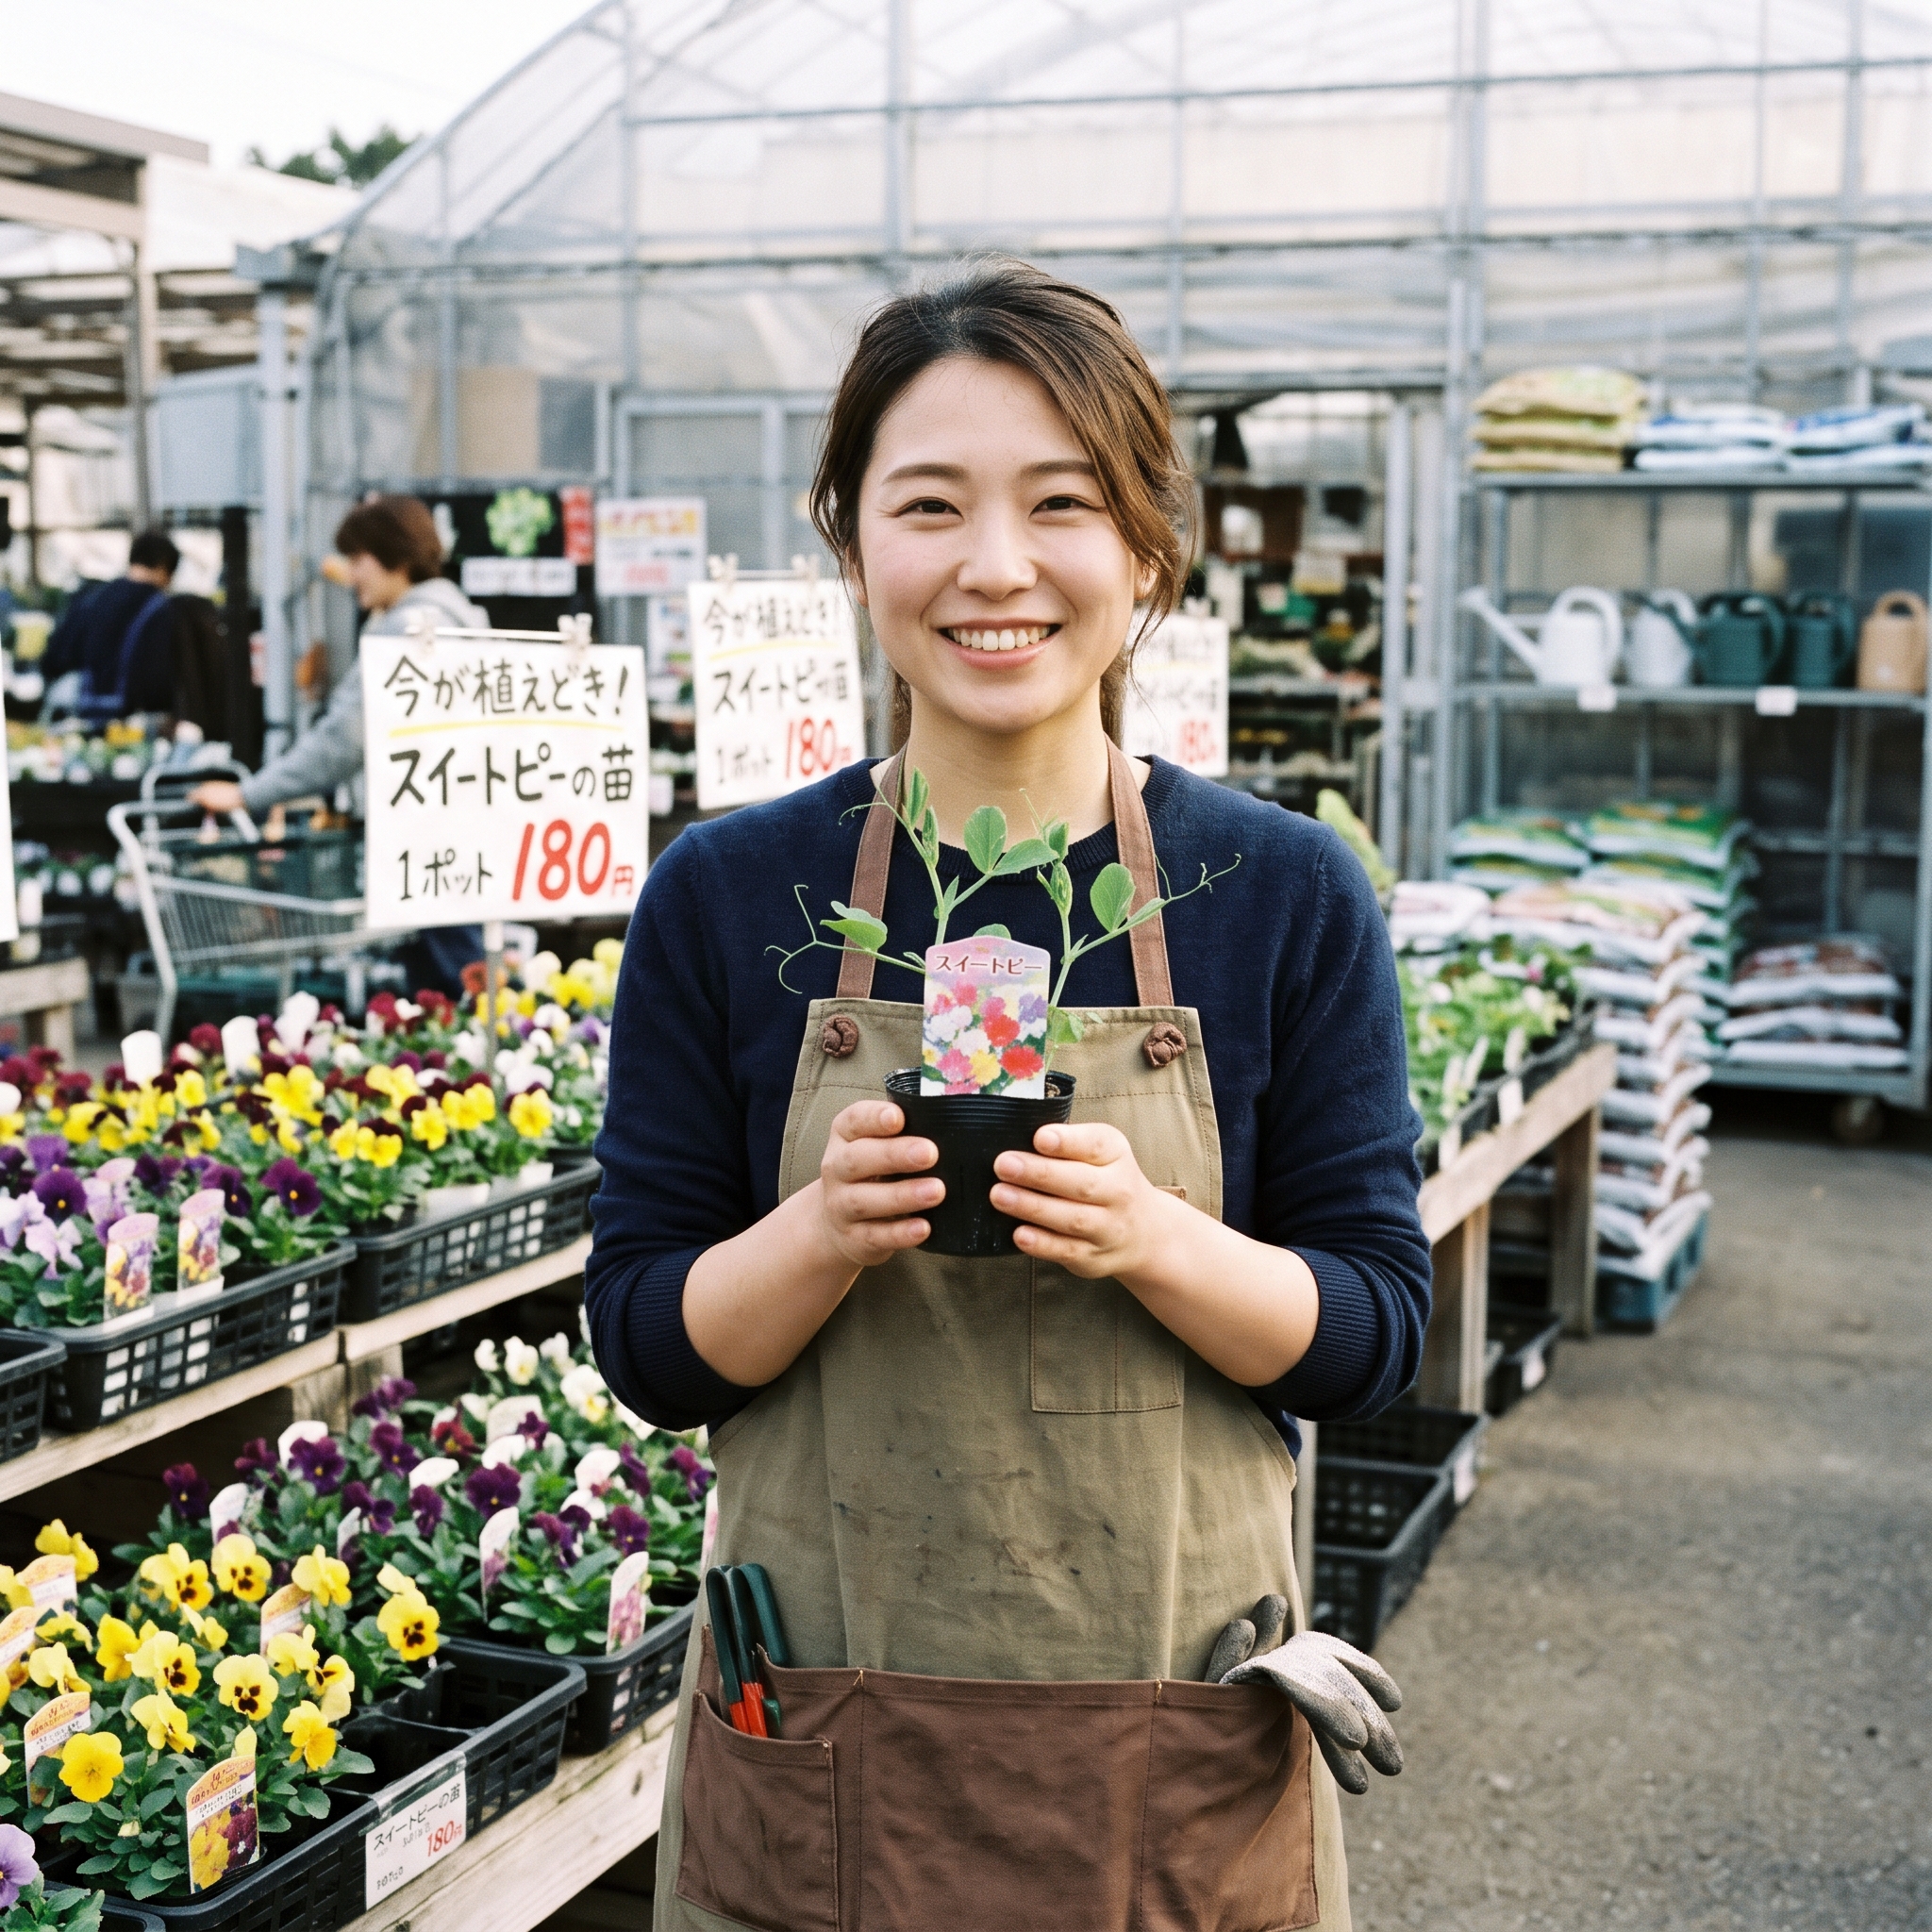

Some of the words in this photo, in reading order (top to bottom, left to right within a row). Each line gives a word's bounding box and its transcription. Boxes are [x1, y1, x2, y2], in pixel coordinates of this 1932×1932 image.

[383, 656, 629, 717] 今が植えどき!
[389, 741, 634, 807] スイートピーの苗
[398, 848, 492, 901] 1ポット
[936, 956, 1042, 974] スイートピー
